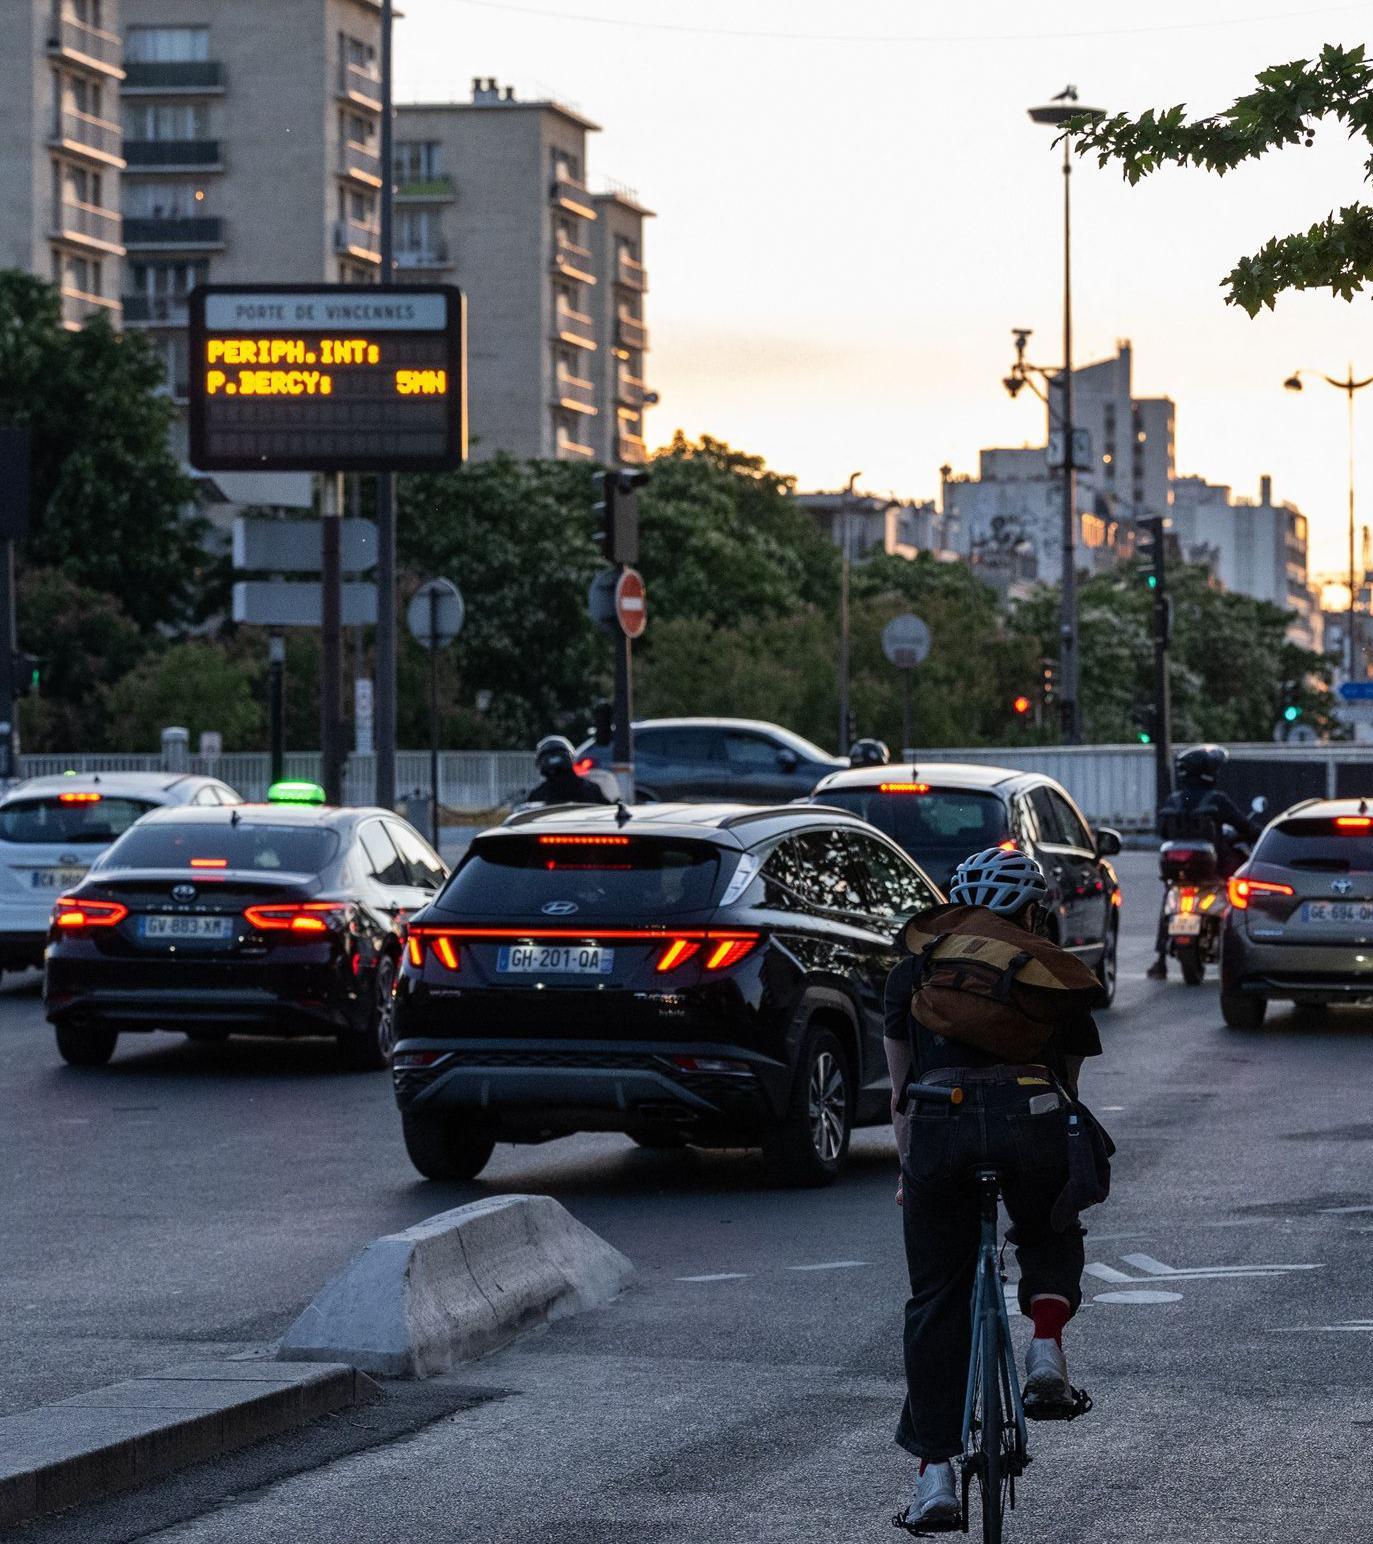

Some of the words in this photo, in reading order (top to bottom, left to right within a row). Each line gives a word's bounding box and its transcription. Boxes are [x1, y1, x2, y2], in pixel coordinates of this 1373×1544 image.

[235, 304, 285, 321] PORTE
[295, 304, 314, 320] DE
[326, 304, 416, 321] VINCENNES
[395, 370, 447, 395] 5MN
